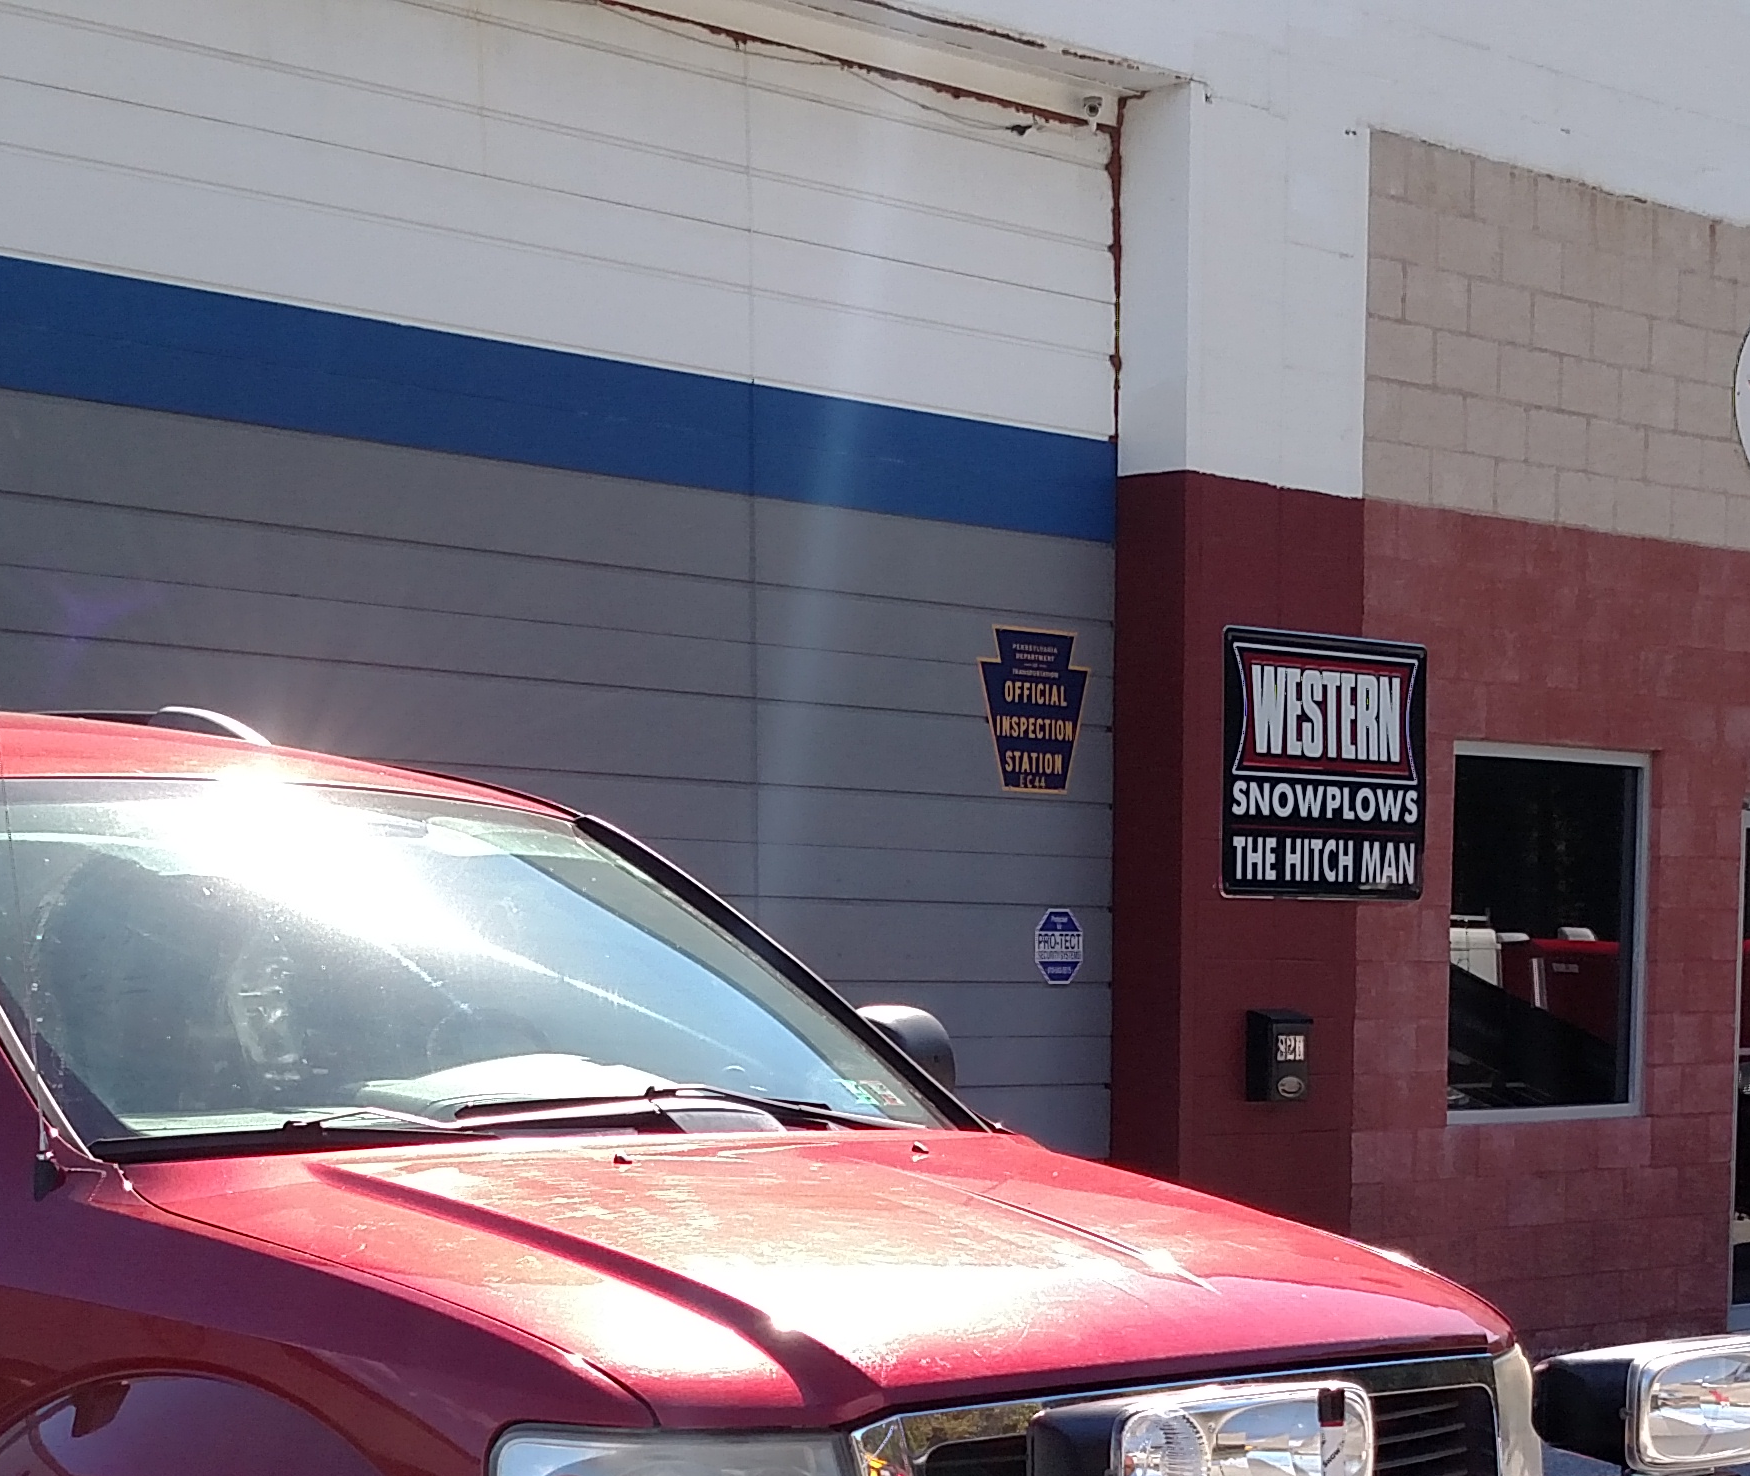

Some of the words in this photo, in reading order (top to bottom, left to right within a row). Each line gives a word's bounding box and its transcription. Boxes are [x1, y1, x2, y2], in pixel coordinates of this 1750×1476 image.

[1004, 680, 1067, 707] OFFICIAL
[1250, 663, 1401, 763] WESTERN
[996, 715, 1073, 742] INSPECTION
[1005, 750, 1062, 775] STATION
[1231, 780, 1419, 824] SNOWPLOWS
[1233, 836, 1277, 881] THE
[1284, 837, 1354, 884] HITCH
[1360, 841, 1415, 885] MAN
[1038, 933, 1081, 950] PRO-TECT
